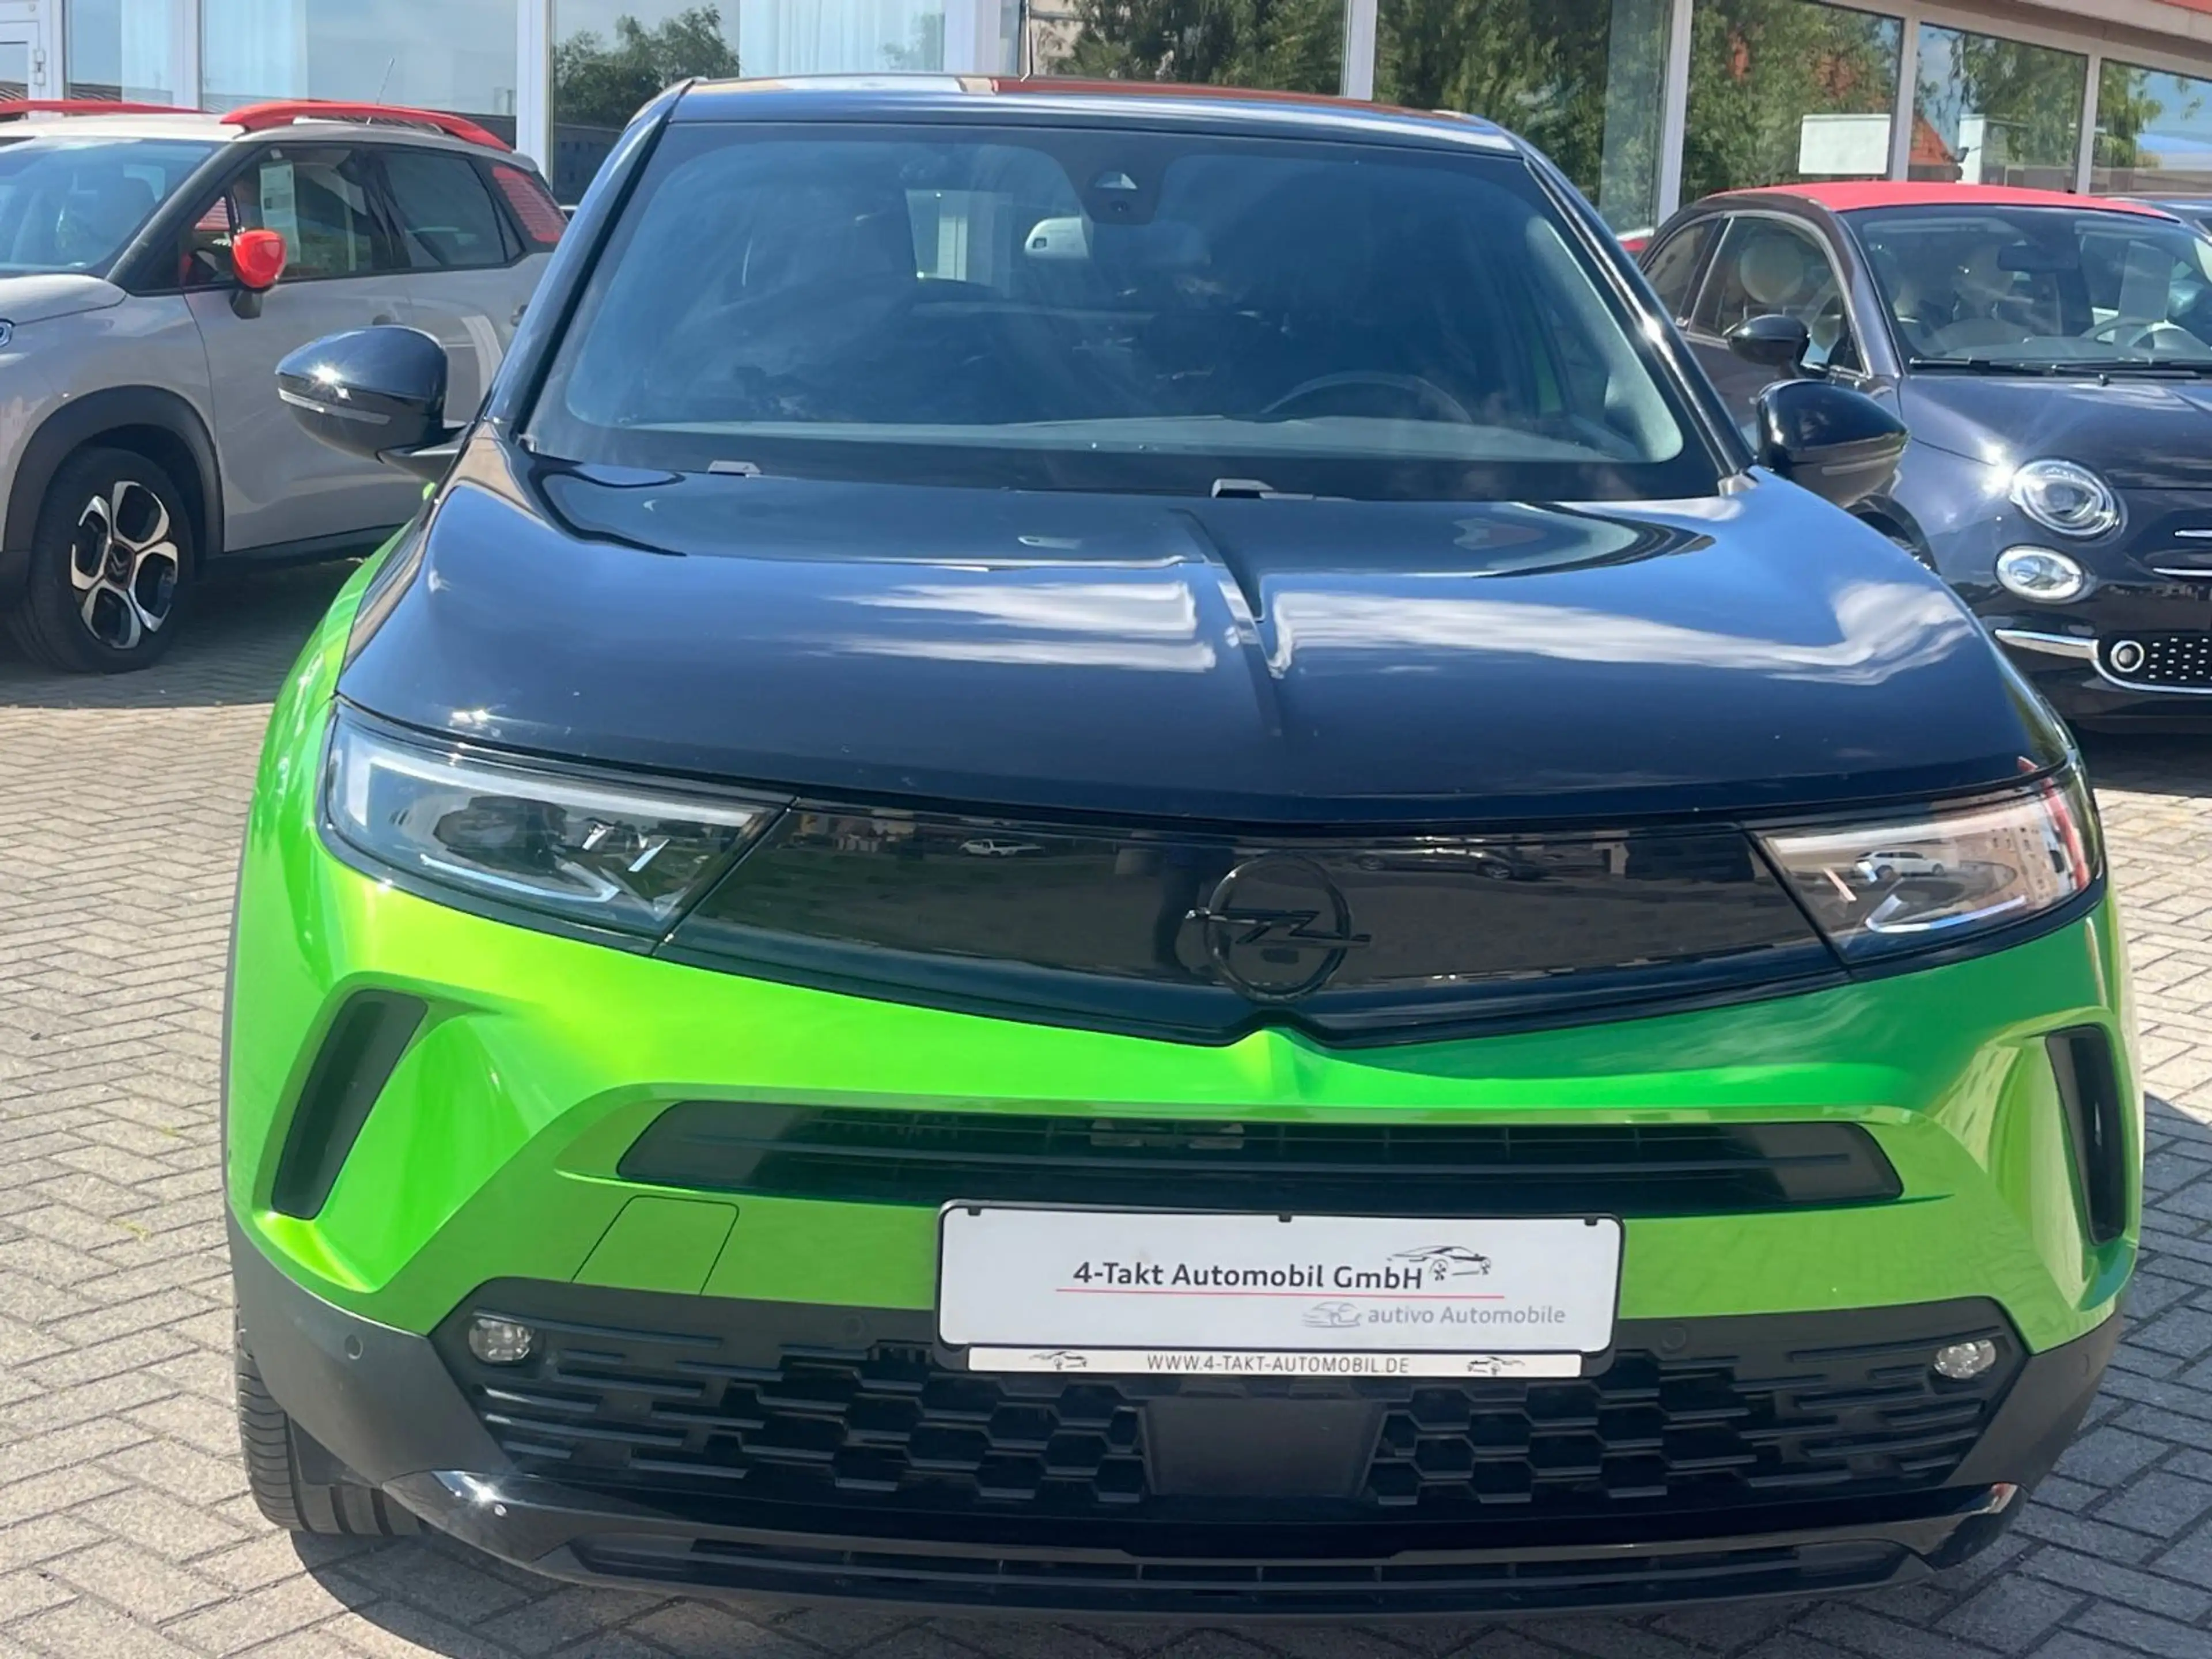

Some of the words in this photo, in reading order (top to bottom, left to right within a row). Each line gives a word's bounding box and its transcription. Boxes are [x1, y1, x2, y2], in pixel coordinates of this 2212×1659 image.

[1073, 1262, 1164, 1285] 4-Takt
[1171, 1263, 1324, 1287] Automobil
[1334, 1266, 1422, 1290] GmbH
[1368, 1306, 1435, 1324] autivo
[1440, 1305, 1567, 1325] Automobile
[1147, 1353, 1410, 1374] WWW.4-TAKT-AUTOMOBIL.DE
